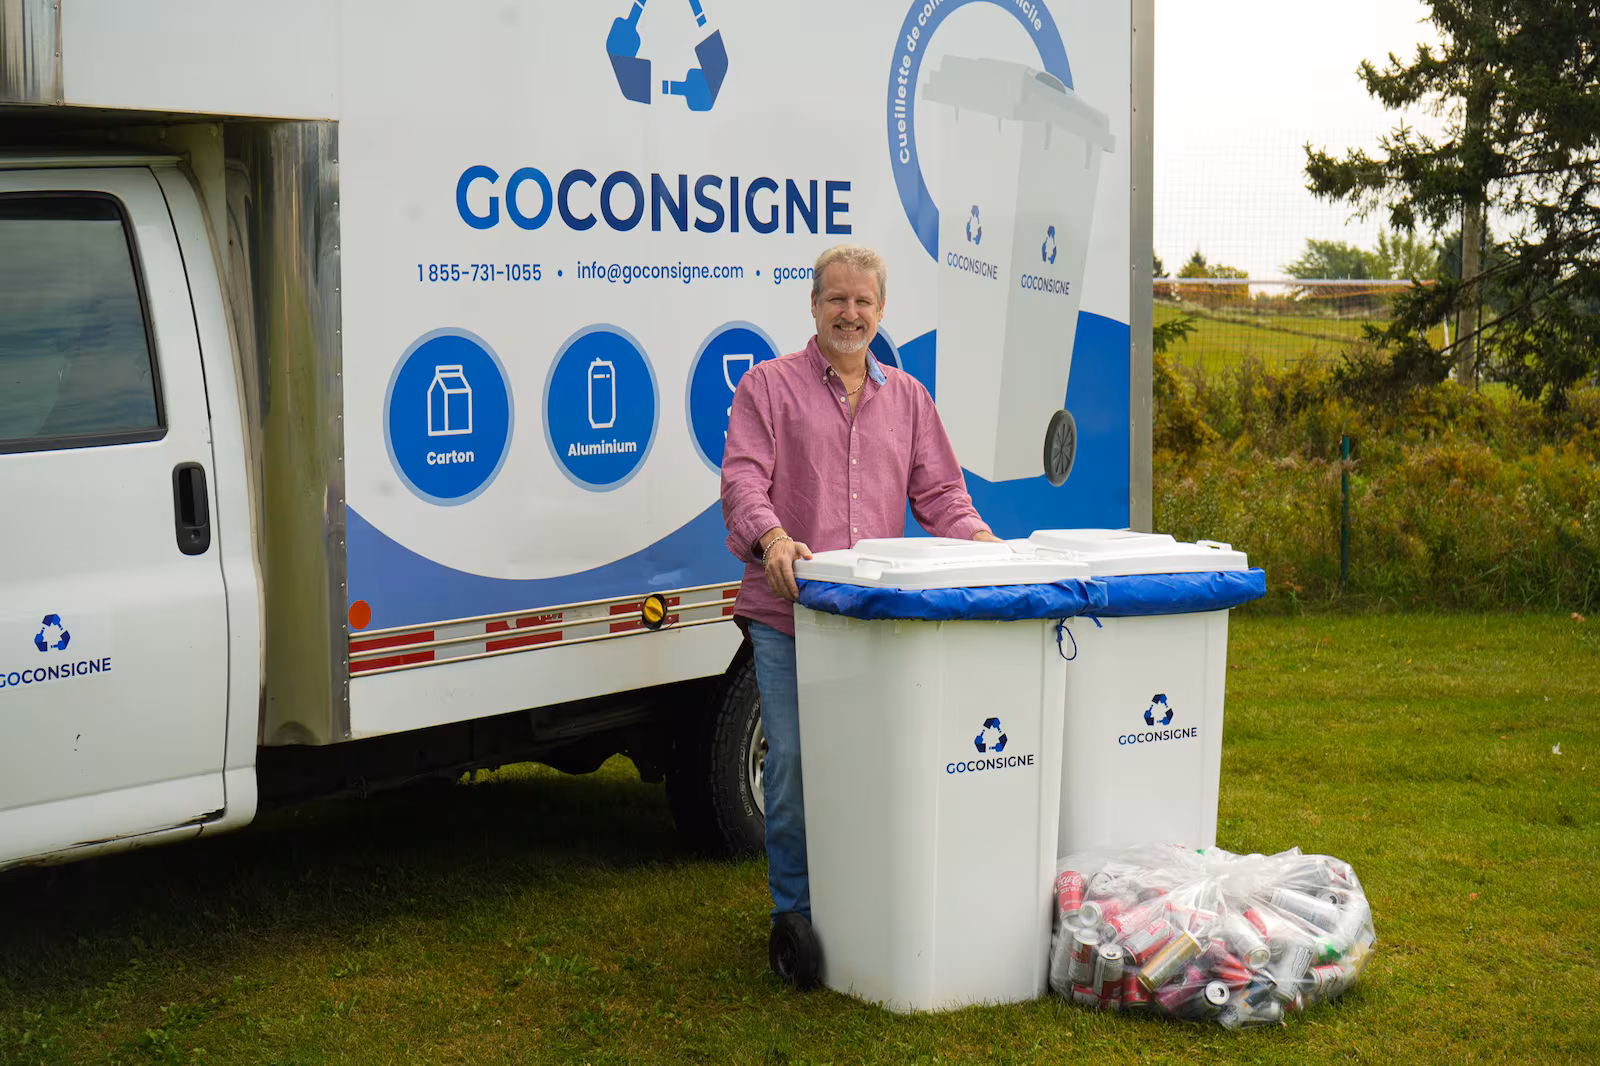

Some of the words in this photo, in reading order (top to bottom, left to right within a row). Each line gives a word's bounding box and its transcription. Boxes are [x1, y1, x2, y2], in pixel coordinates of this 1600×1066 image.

[907, 26, 920, 52] de
[456, 164, 852, 235] GOCONSIGNE
[428, 263, 542, 282] 855-731-1055
[577, 260, 744, 284] info@goconsigne.com
[947, 252, 998, 280] GOCONSIGNE
[1021, 274, 1070, 296] GOCONSIGNE
[426, 449, 475, 466] Carton
[567, 439, 637, 457] Aluminium
[1118, 726, 1198, 746] GOCONSIGNE
[946, 753, 1035, 774] GOCONSIGNE
